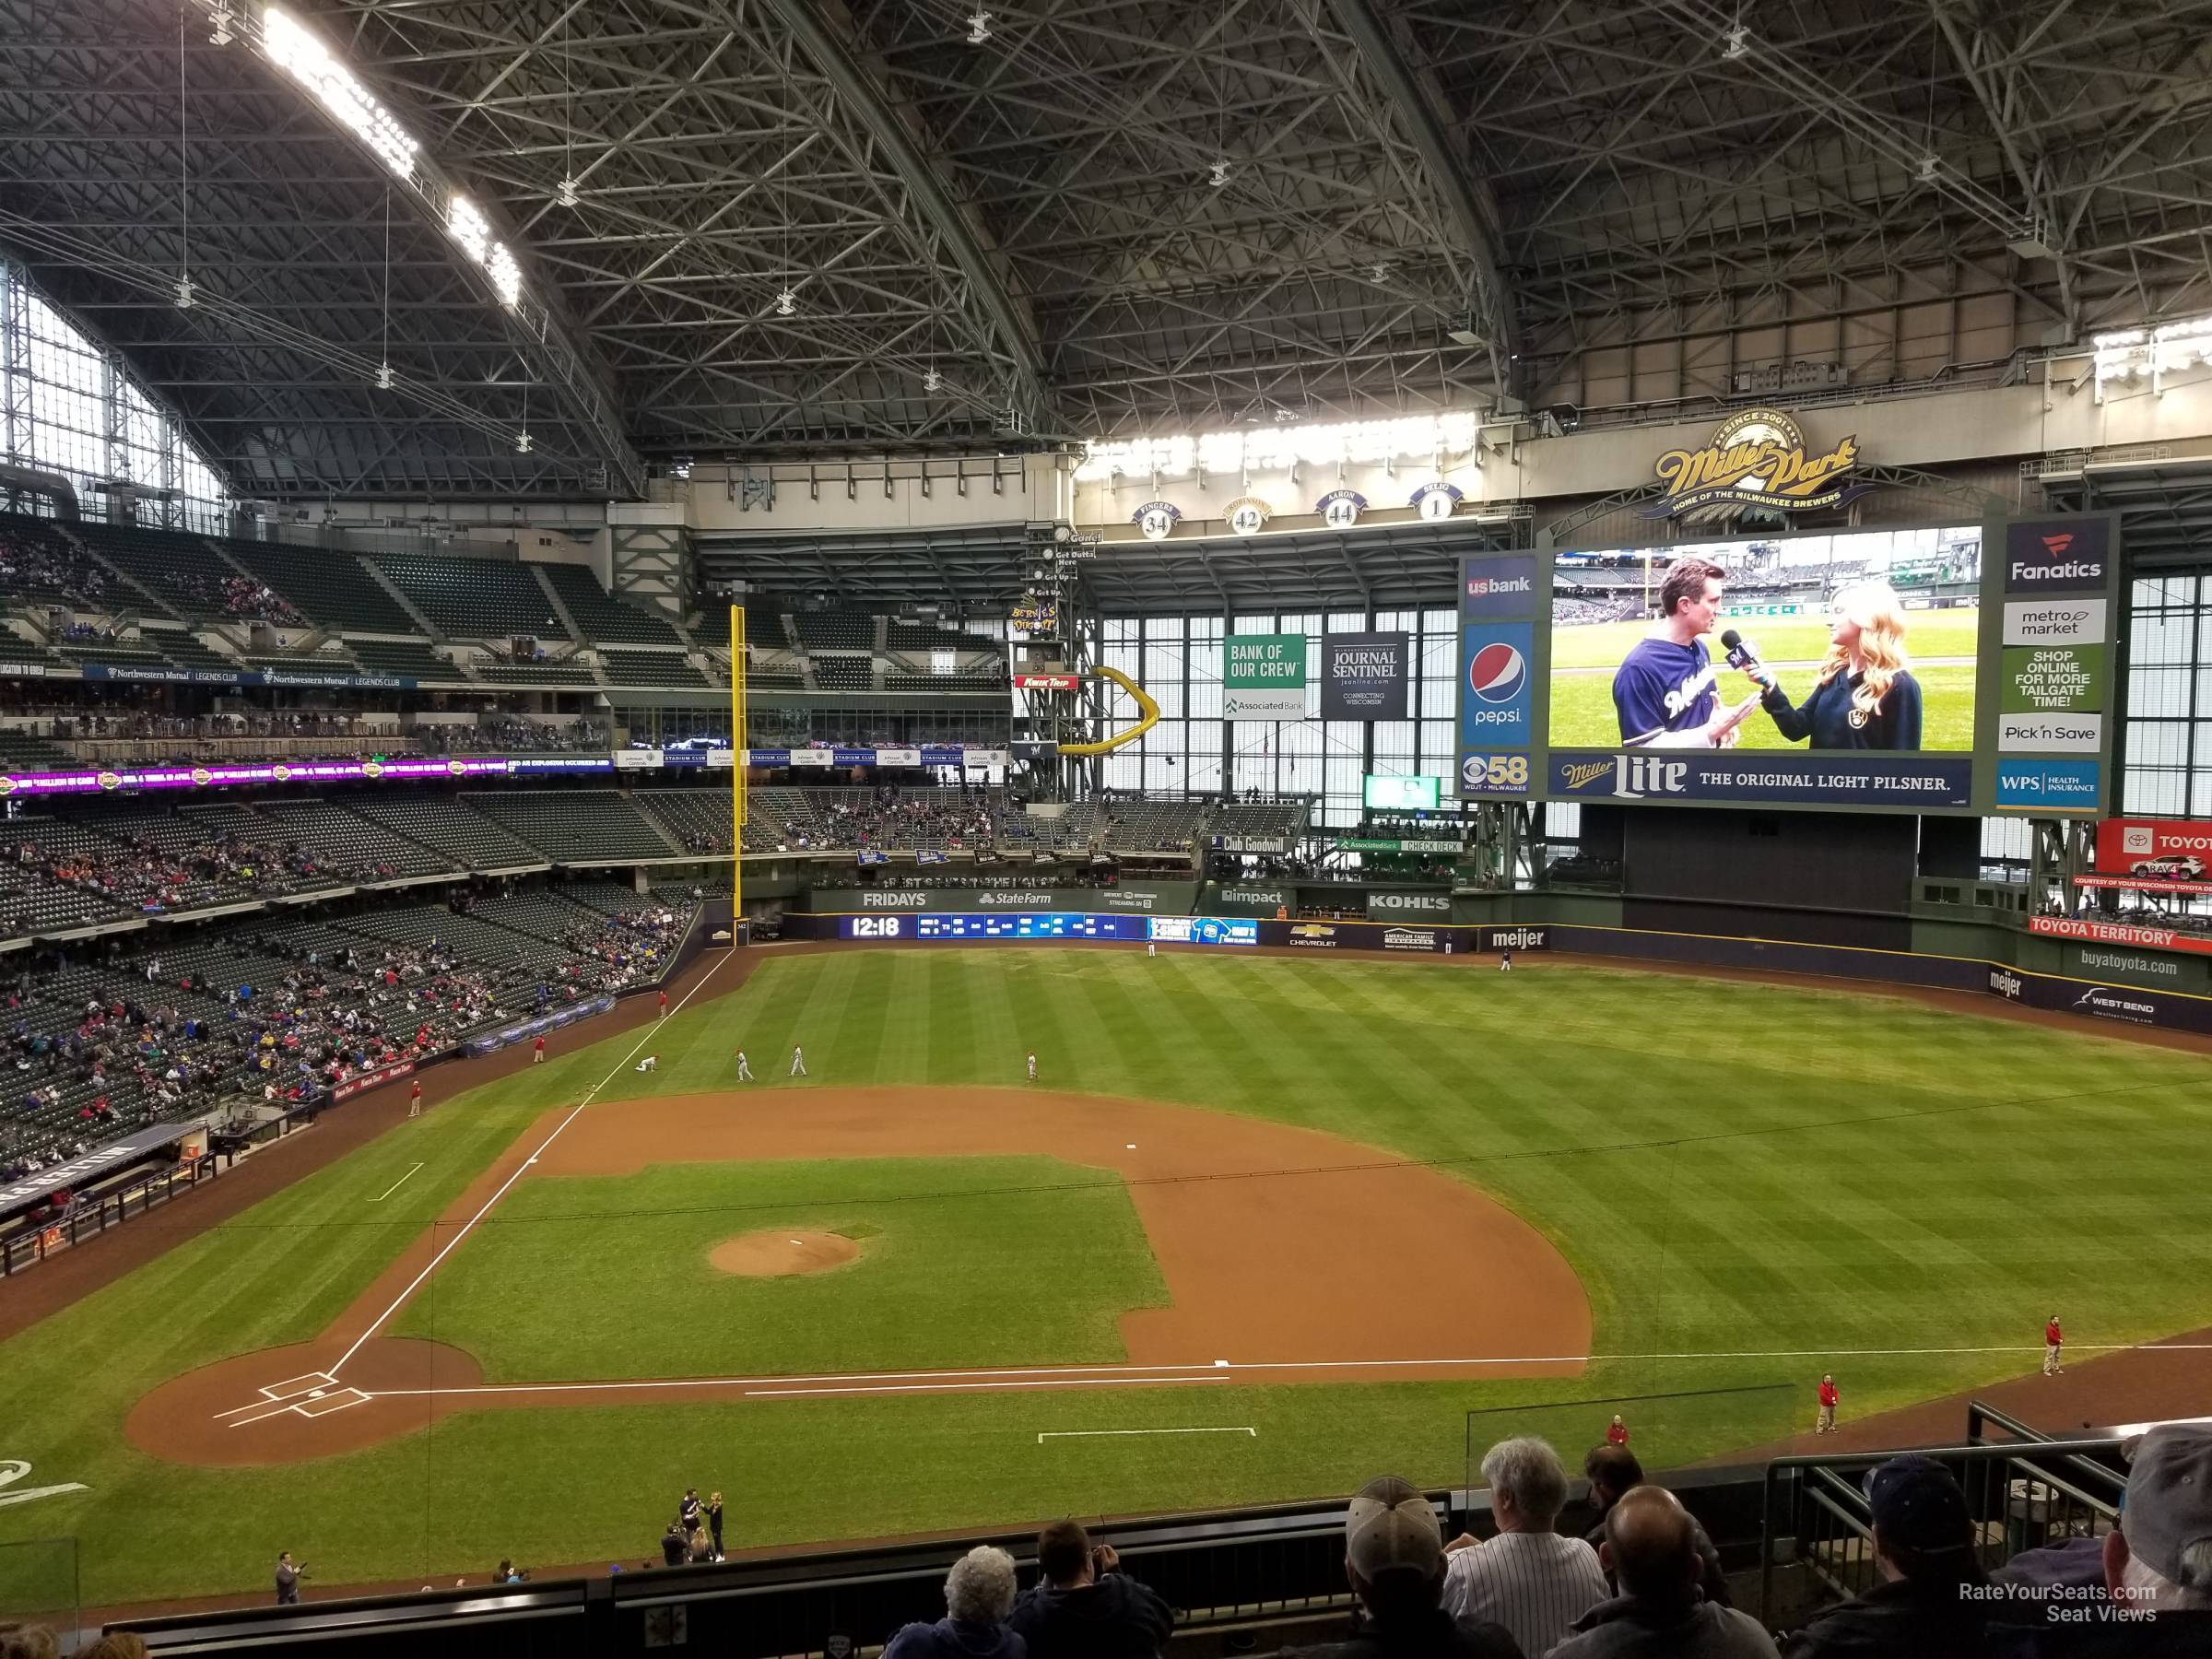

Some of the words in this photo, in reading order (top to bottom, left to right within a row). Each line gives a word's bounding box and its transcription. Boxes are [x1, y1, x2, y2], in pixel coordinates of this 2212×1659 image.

[1724, 412, 1759, 434] SINCE
[1762, 412, 1788, 429] 2001
[1656, 438, 1780, 496] Miller
[1752, 439, 1854, 494] Park
[1423, 483, 1450, 493] SELIG
[1328, 491, 1356, 502] AARON
[1673, 496, 1699, 512] HOME
[1700, 491, 1713, 501] OF
[1715, 490, 1734, 500] THE
[1735, 491, 1792, 508] MILWAUKEE
[1793, 491, 1841, 508] BREWERS
[1140, 501, 1173, 514] FINGERS
[1328, 504, 1352, 524] 44
[1431, 499, 1443, 518] 1
[1146, 515, 1169, 534] 34
[1235, 511, 1257, 529] 42
[2012, 559, 2101, 581] Fanatics
[2022, 610, 2072, 622] metro
[2022, 622, 2079, 634] market
[1230, 645, 1265, 660] BANK
[1267, 644, 1283, 660] OF
[1333, 651, 1398, 666] JOURNAL
[2033, 651, 2074, 662] SHOP
[1230, 662, 1255, 677] OUR
[1333, 665, 1397, 678] SENTINEL
[2027, 662, 2080, 673] ONLINE
[117, 669, 165, 679] Northwestern
[166, 671, 190, 680] Mutual
[195, 673, 221, 681] LEGENDS
[222, 673, 238, 682] CLUB
[273, 675, 323, 685] Northwestern
[324, 677, 349, 686] Mutual
[355, 677, 383, 687] LEGENDS
[383, 678, 400, 687] CLUB
[2015, 674, 2043, 685] FOR
[2048, 673, 2091, 684] MORE
[2019, 685, 2086, 696] TAILGATE
[1238, 700, 1284, 711] Associated
[1284, 700, 1303, 711] Bank
[2032, 696, 2071, 707] TIME!
[1475, 707, 1520, 726] pepsi
[2005, 726, 2039, 739] Pick
[2055, 726, 2096, 739] Save
[1487, 756, 1529, 785] 58
[1560, 761, 1615, 789] Miller
[1612, 754, 1688, 799] Lite
[1700, 772, 1732, 785] THE
[1735, 773, 1813, 787] ORIGINAL
[1818, 775, 1870, 789] LIGHT
[1874, 776, 1951, 792] PILSNER.
[2002, 776, 2040, 790] WPS
[1224, 836, 1243, 852] Club
[1245, 836, 1284, 853] Goodwill
[1350, 841, 1383, 850] Associated
[1407, 841, 1435, 852] CHECK
[1437, 842, 1458, 853] DECK
[2150, 865, 2177, 874] RAV4
[2136, 881, 2175, 889] WISCONSIN
[864, 892, 926, 907] FRIDAYS
[1233, 888, 1282, 904] impact
[1369, 895, 1451, 911] KOHL'S
[853, 917, 900, 936] 12:18
[2032, 918, 2088, 936] TOYOTA
[2090, 924, 2175, 946] TERRITORY
[1289, 939, 1337, 947] CHEVROLET
[1493, 928, 1544, 950] meijer
[2081, 949, 2178, 975] buyatoyota.com
[1990, 971, 2022, 998] meijer
[2092, 996, 2123, 1009] WEST
[2123, 1000, 2154, 1014] BEND
[25, 1147, 136, 1185] MILLER
